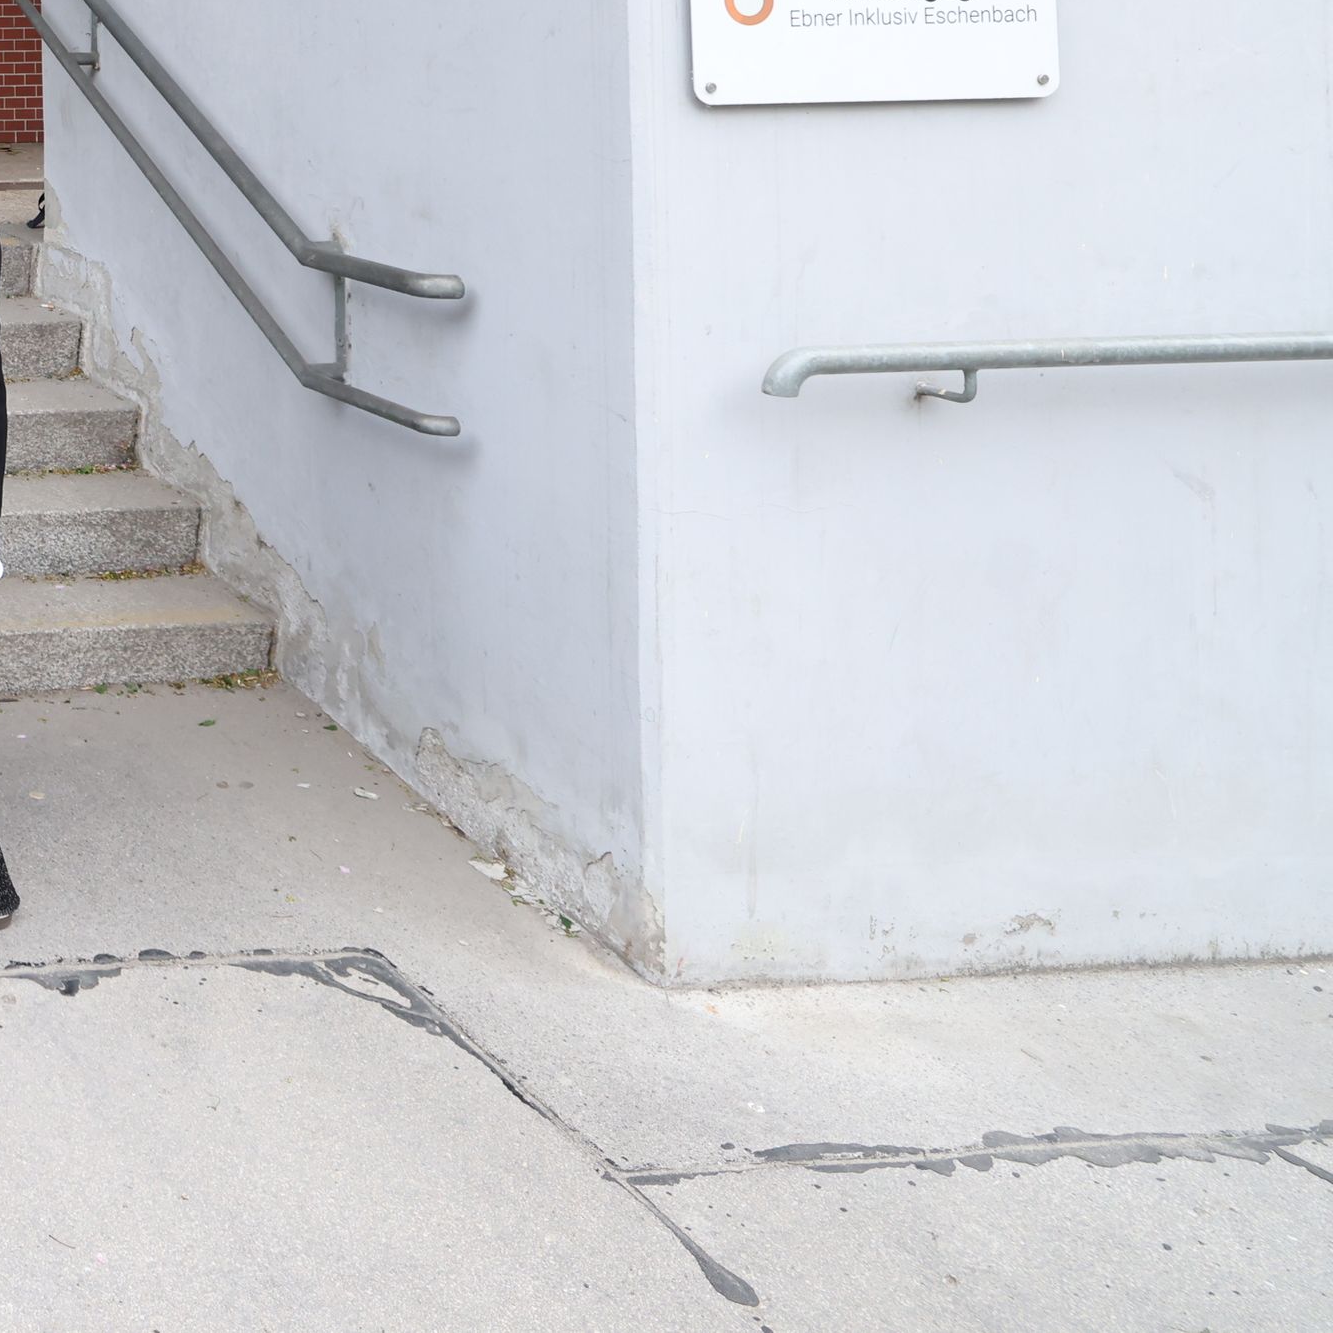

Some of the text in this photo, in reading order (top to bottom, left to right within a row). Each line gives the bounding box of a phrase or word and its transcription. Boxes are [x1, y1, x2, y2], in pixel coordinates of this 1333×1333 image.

[789, 5, 1038, 28] Ebner Inklusiv Eschenbach
